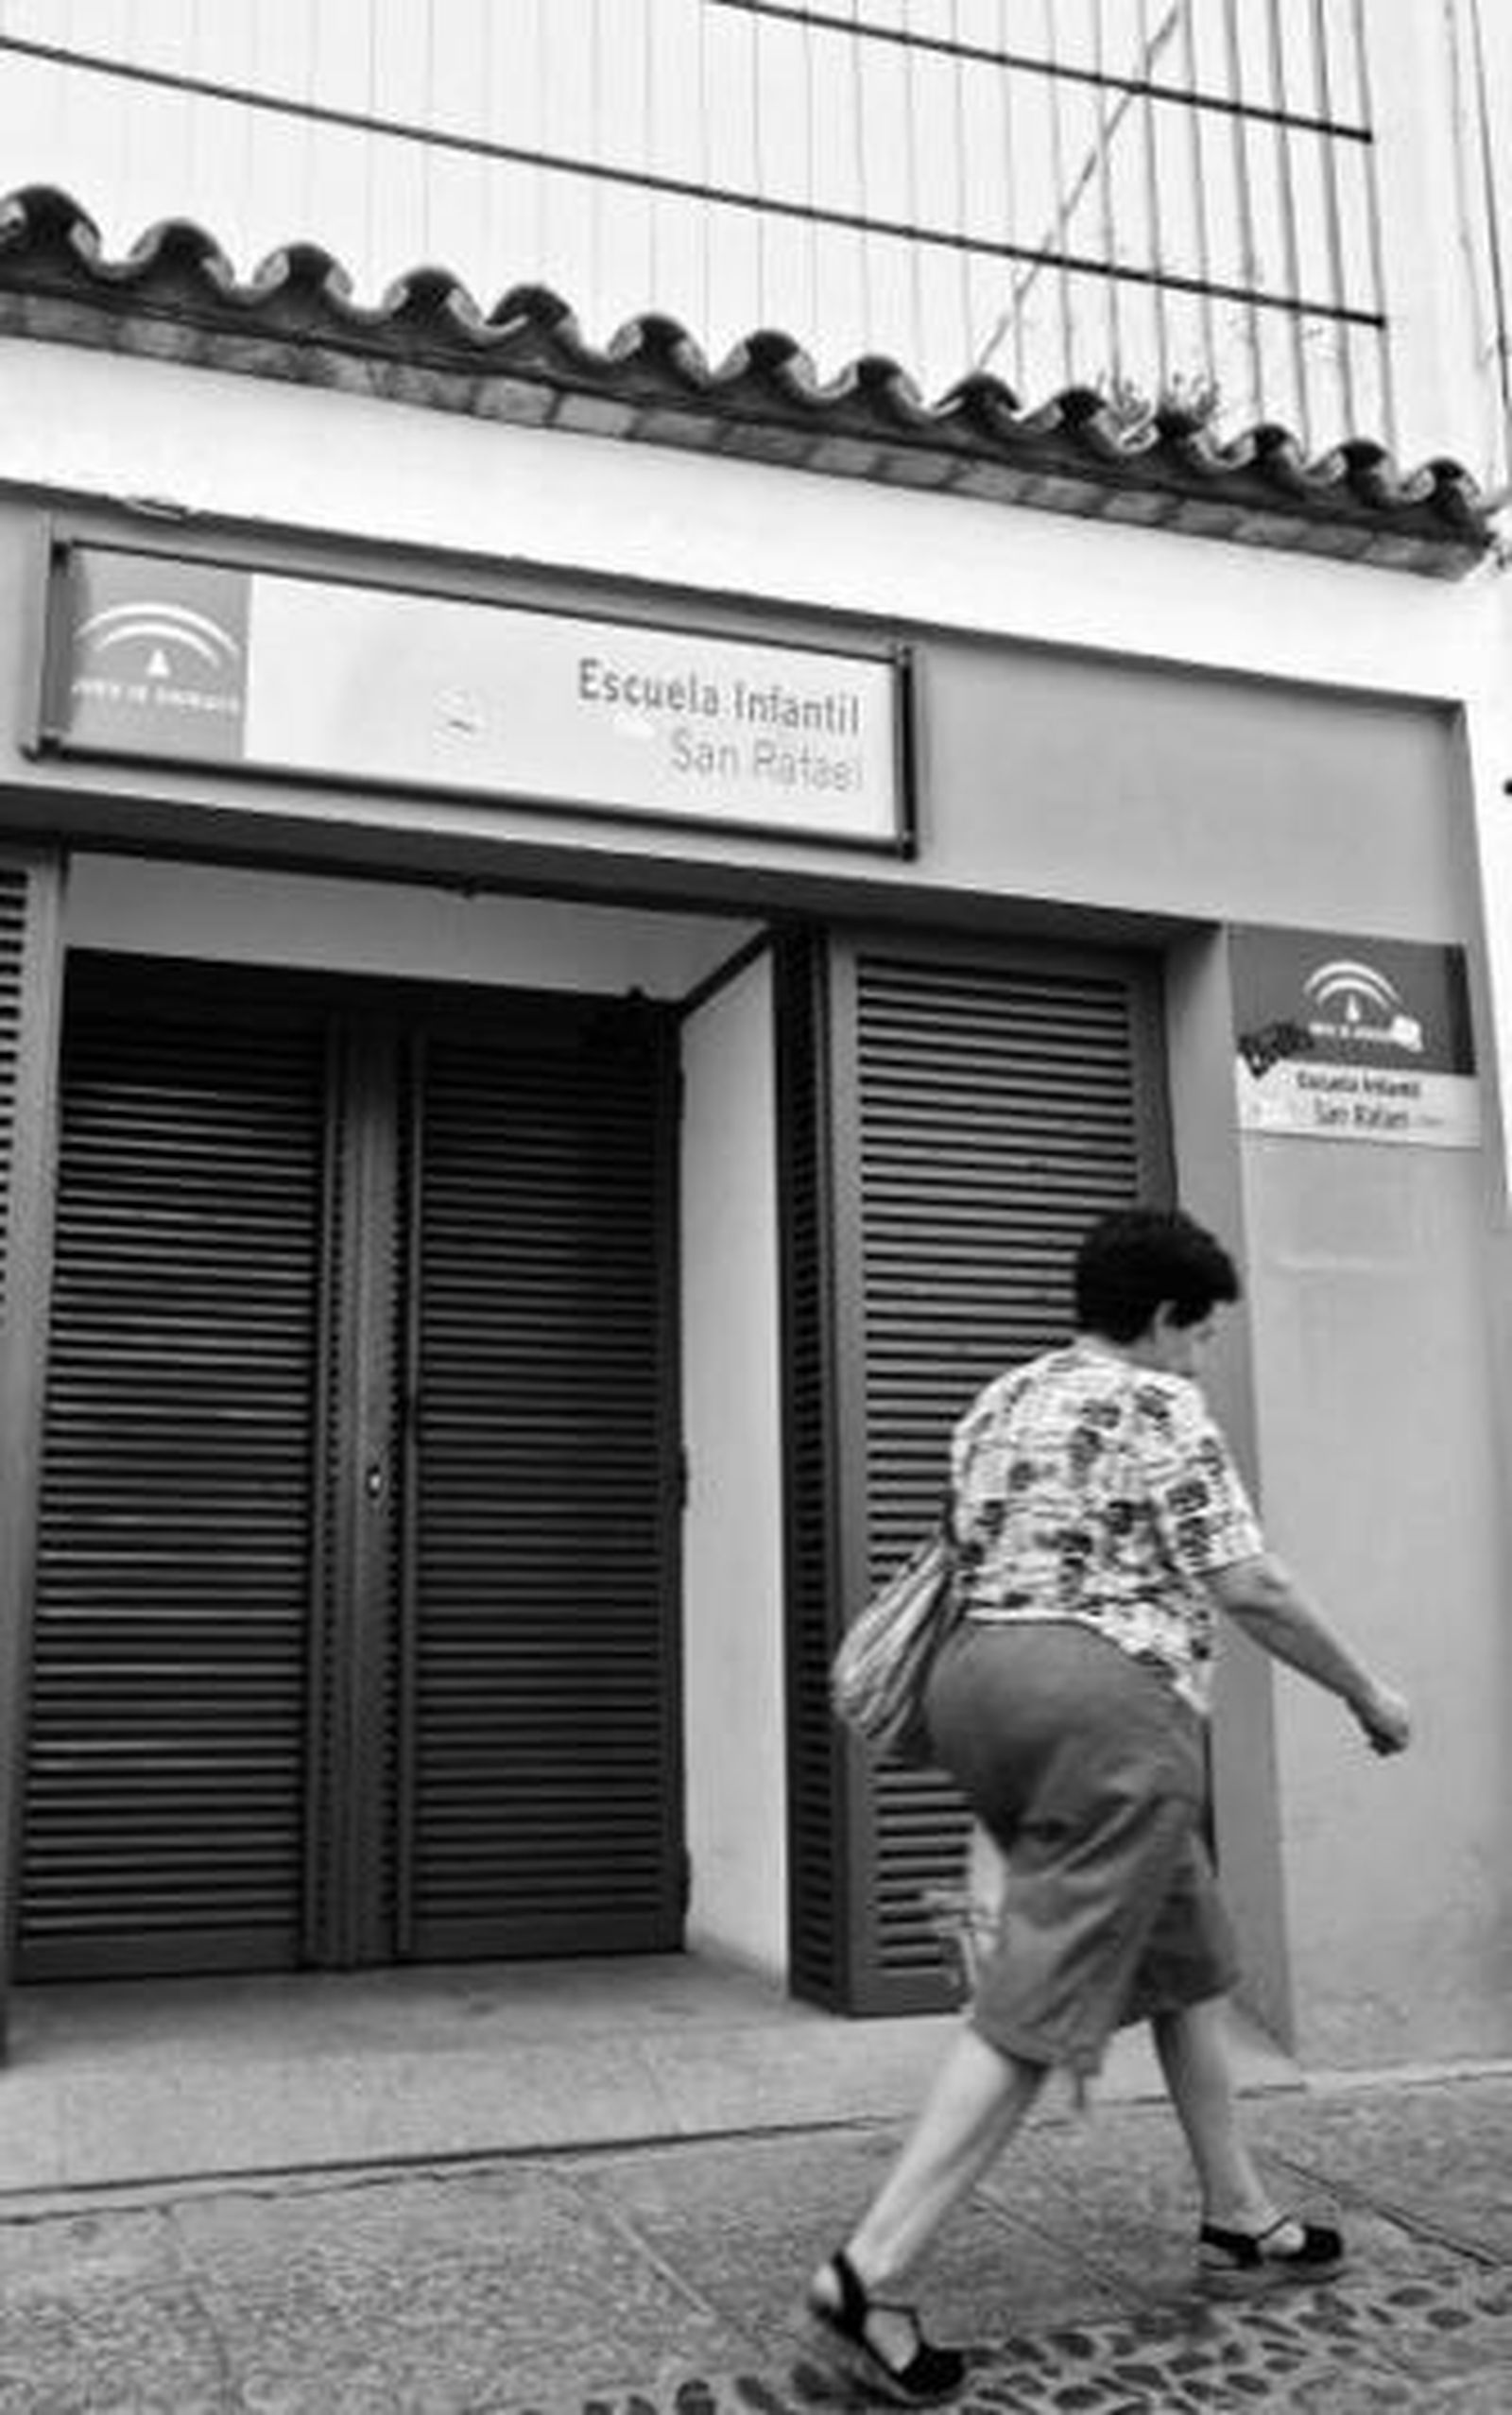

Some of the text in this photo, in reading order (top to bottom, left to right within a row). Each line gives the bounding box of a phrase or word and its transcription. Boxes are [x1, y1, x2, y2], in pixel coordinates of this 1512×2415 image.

[578, 657, 859, 735] Escuela Infantil
[672, 726, 740, 775] San
